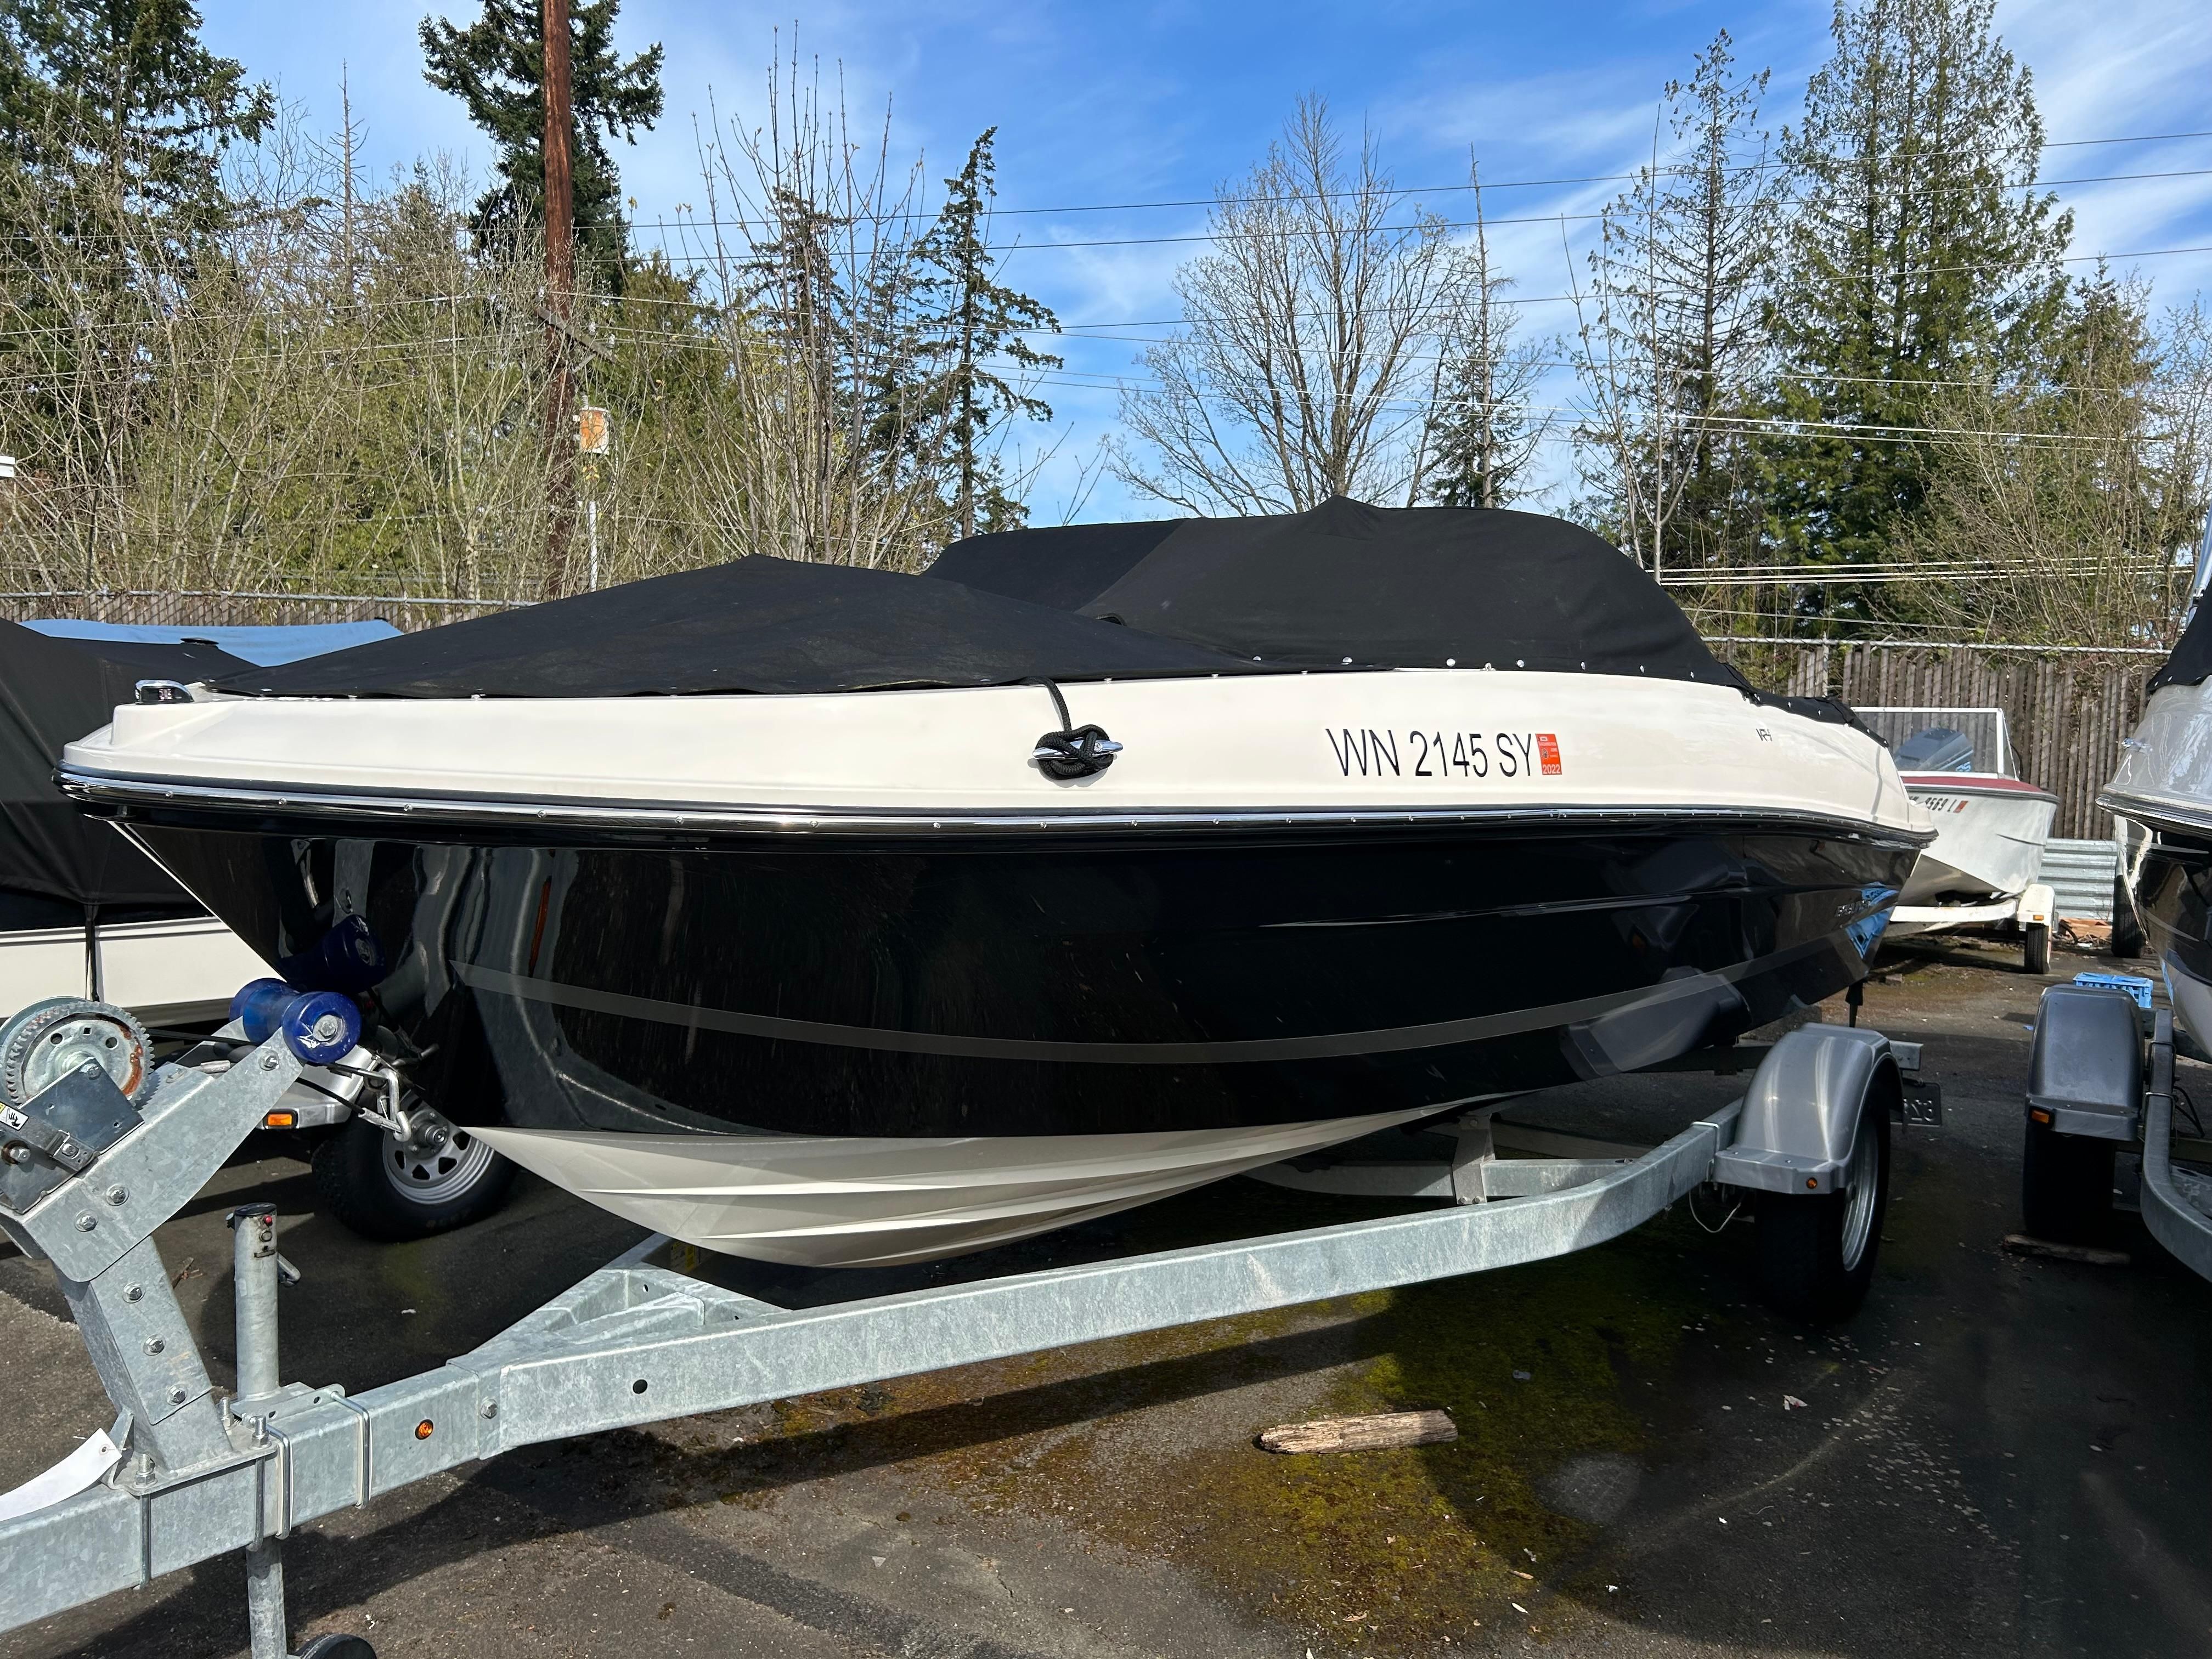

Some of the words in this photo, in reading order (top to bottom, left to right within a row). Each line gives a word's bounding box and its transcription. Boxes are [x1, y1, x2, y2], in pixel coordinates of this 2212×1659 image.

[1325, 729, 1400, 776] WN
[1410, 731, 1487, 777] 2145
[1497, 733, 1531, 777] SY
[1542, 764, 1561, 774] 2022
